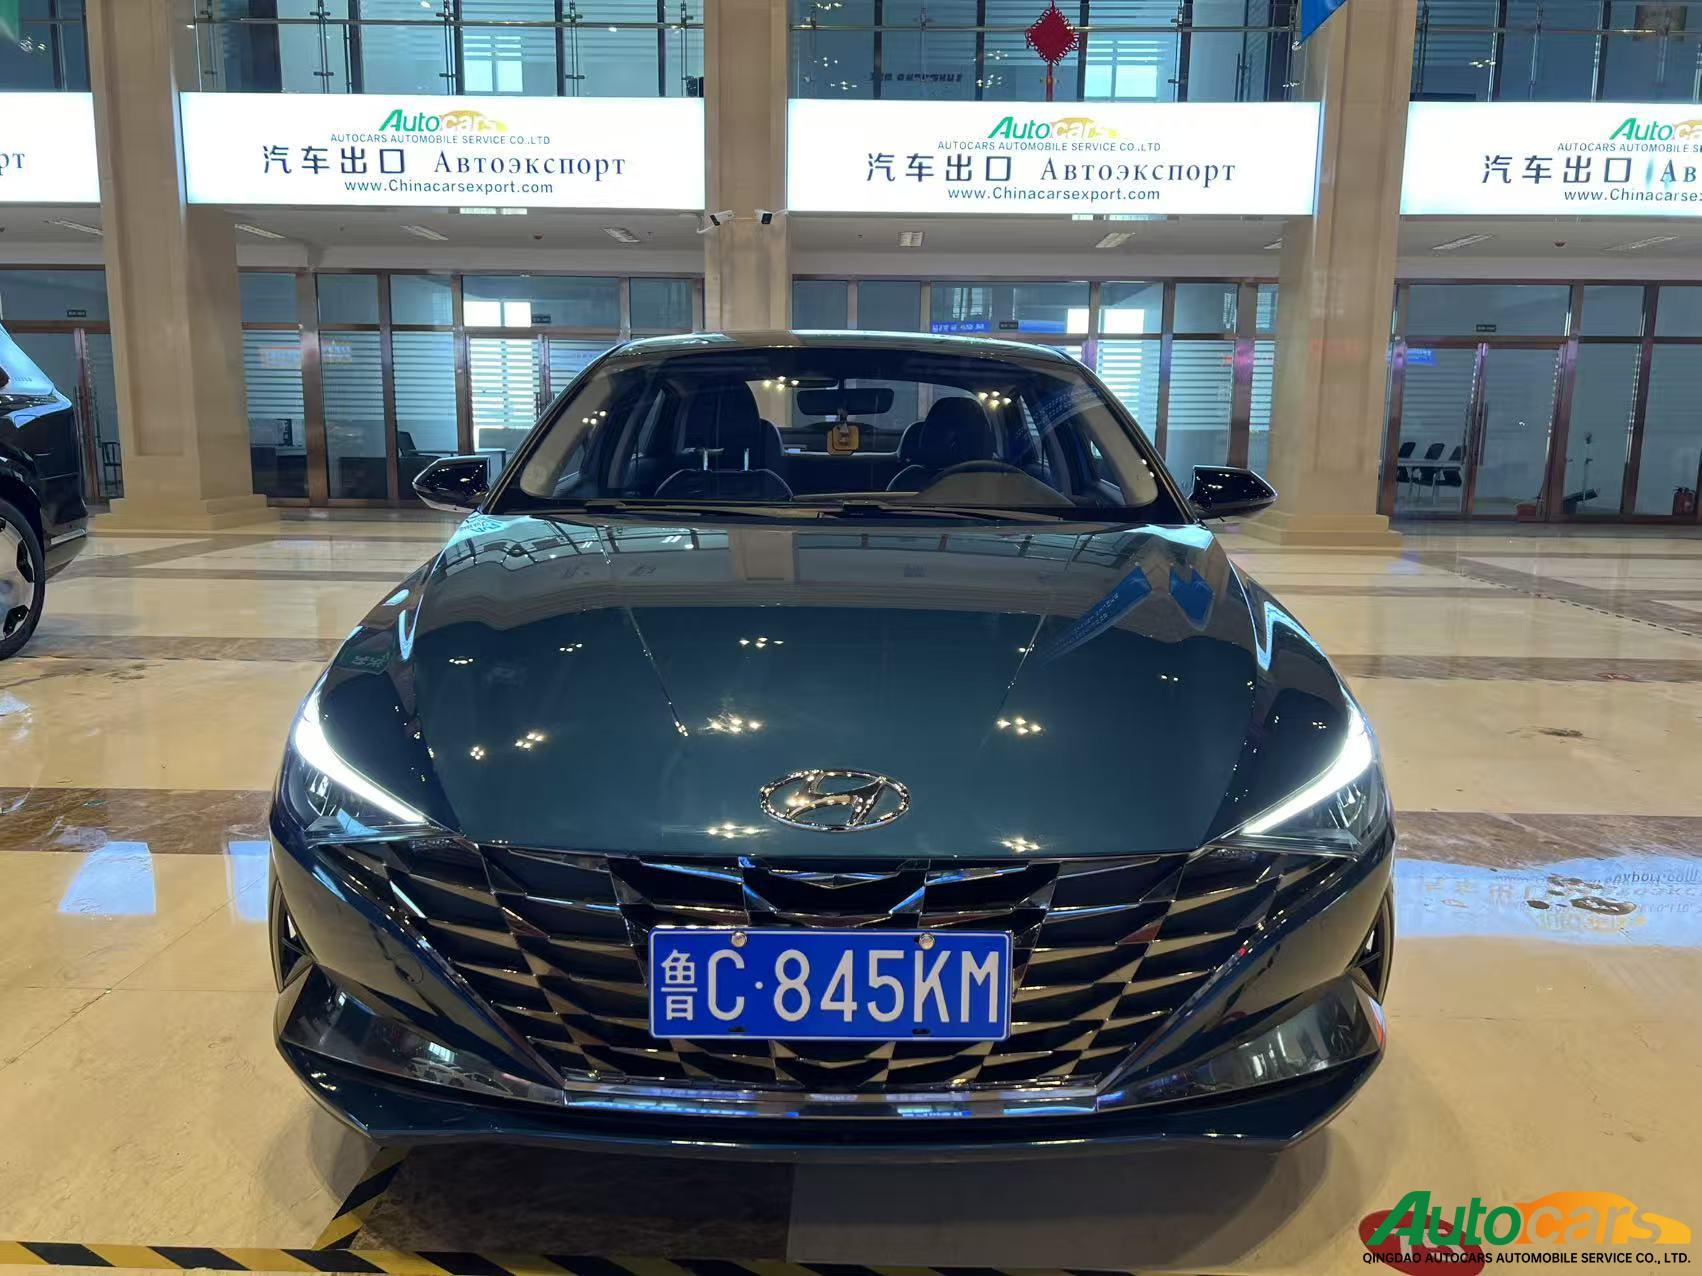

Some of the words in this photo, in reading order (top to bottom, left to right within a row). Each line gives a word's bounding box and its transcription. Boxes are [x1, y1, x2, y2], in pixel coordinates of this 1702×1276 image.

[330, 134, 388, 143] AUTOCARS
[391, 135, 458, 144] AUTOMOBILE
[462, 135, 506, 145] SERVICE
[937, 141, 995, 151] AUTOCARS
[998, 141, 1068, 151] AUTOMOBILE
[1071, 142, 1116, 151] SERVICE
[1557, 142, 1616, 152] AUTOCARS
[1619, 143, 1690, 153] AUTOMOBILE
[263, 145, 405, 174] 汽车出口
[434, 150, 626, 182] Автоэкспорт
[867, 152, 1012, 182] 汽车出口
[1041, 156, 1236, 188] Автоэкспорт
[1482, 154, 1633, 184] 汽车出口
[344, 179, 553, 195] www.Chinacarsexport.com
[948, 186, 1160, 203] www.Chinacarsexport.com
